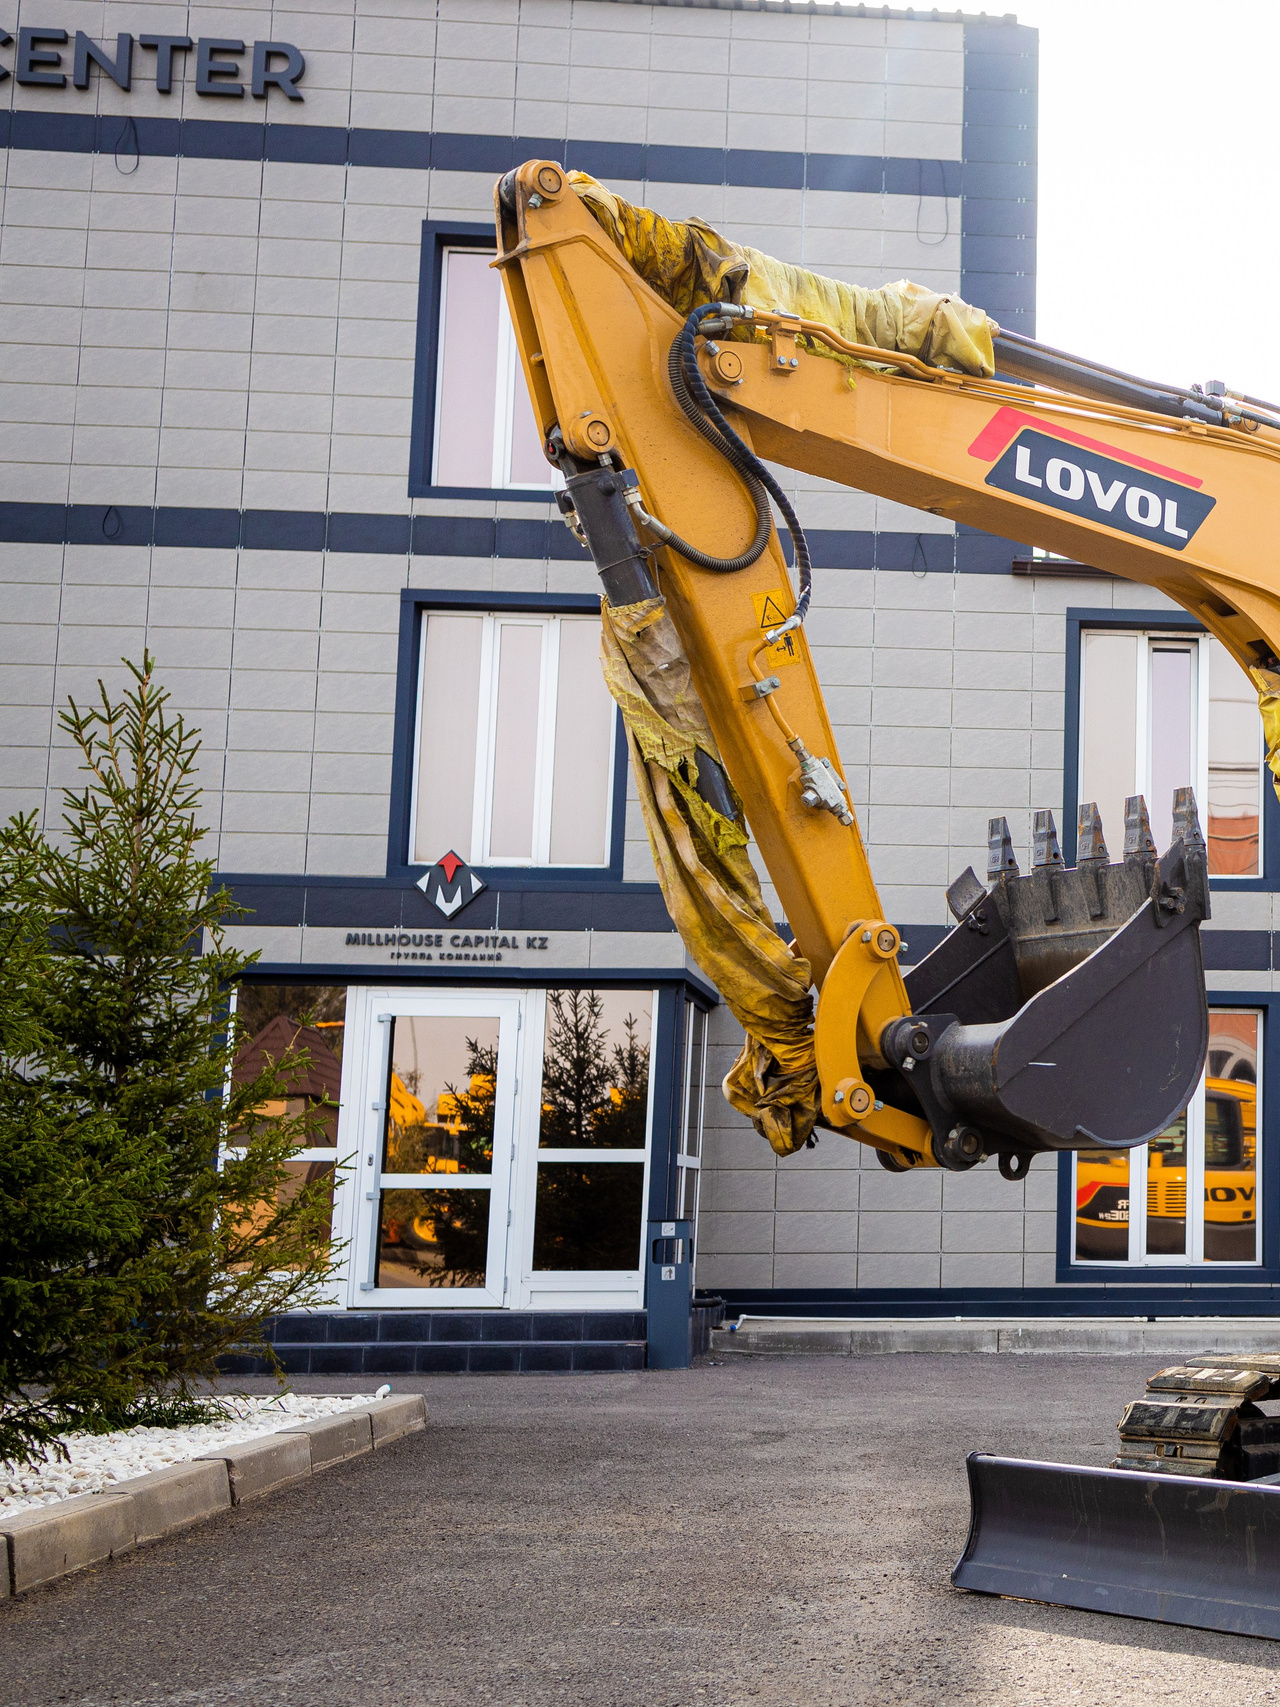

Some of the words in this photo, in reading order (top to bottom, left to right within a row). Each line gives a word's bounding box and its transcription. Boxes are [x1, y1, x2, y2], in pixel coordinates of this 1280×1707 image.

[0, 27, 306, 102] ENTER
[1015, 445, 1188, 539] LOVOL
[345, 933, 443, 947] MILLHOUSE
[450, 935, 519, 949] CAPITAL
[526, 937, 549, 949] KZ
